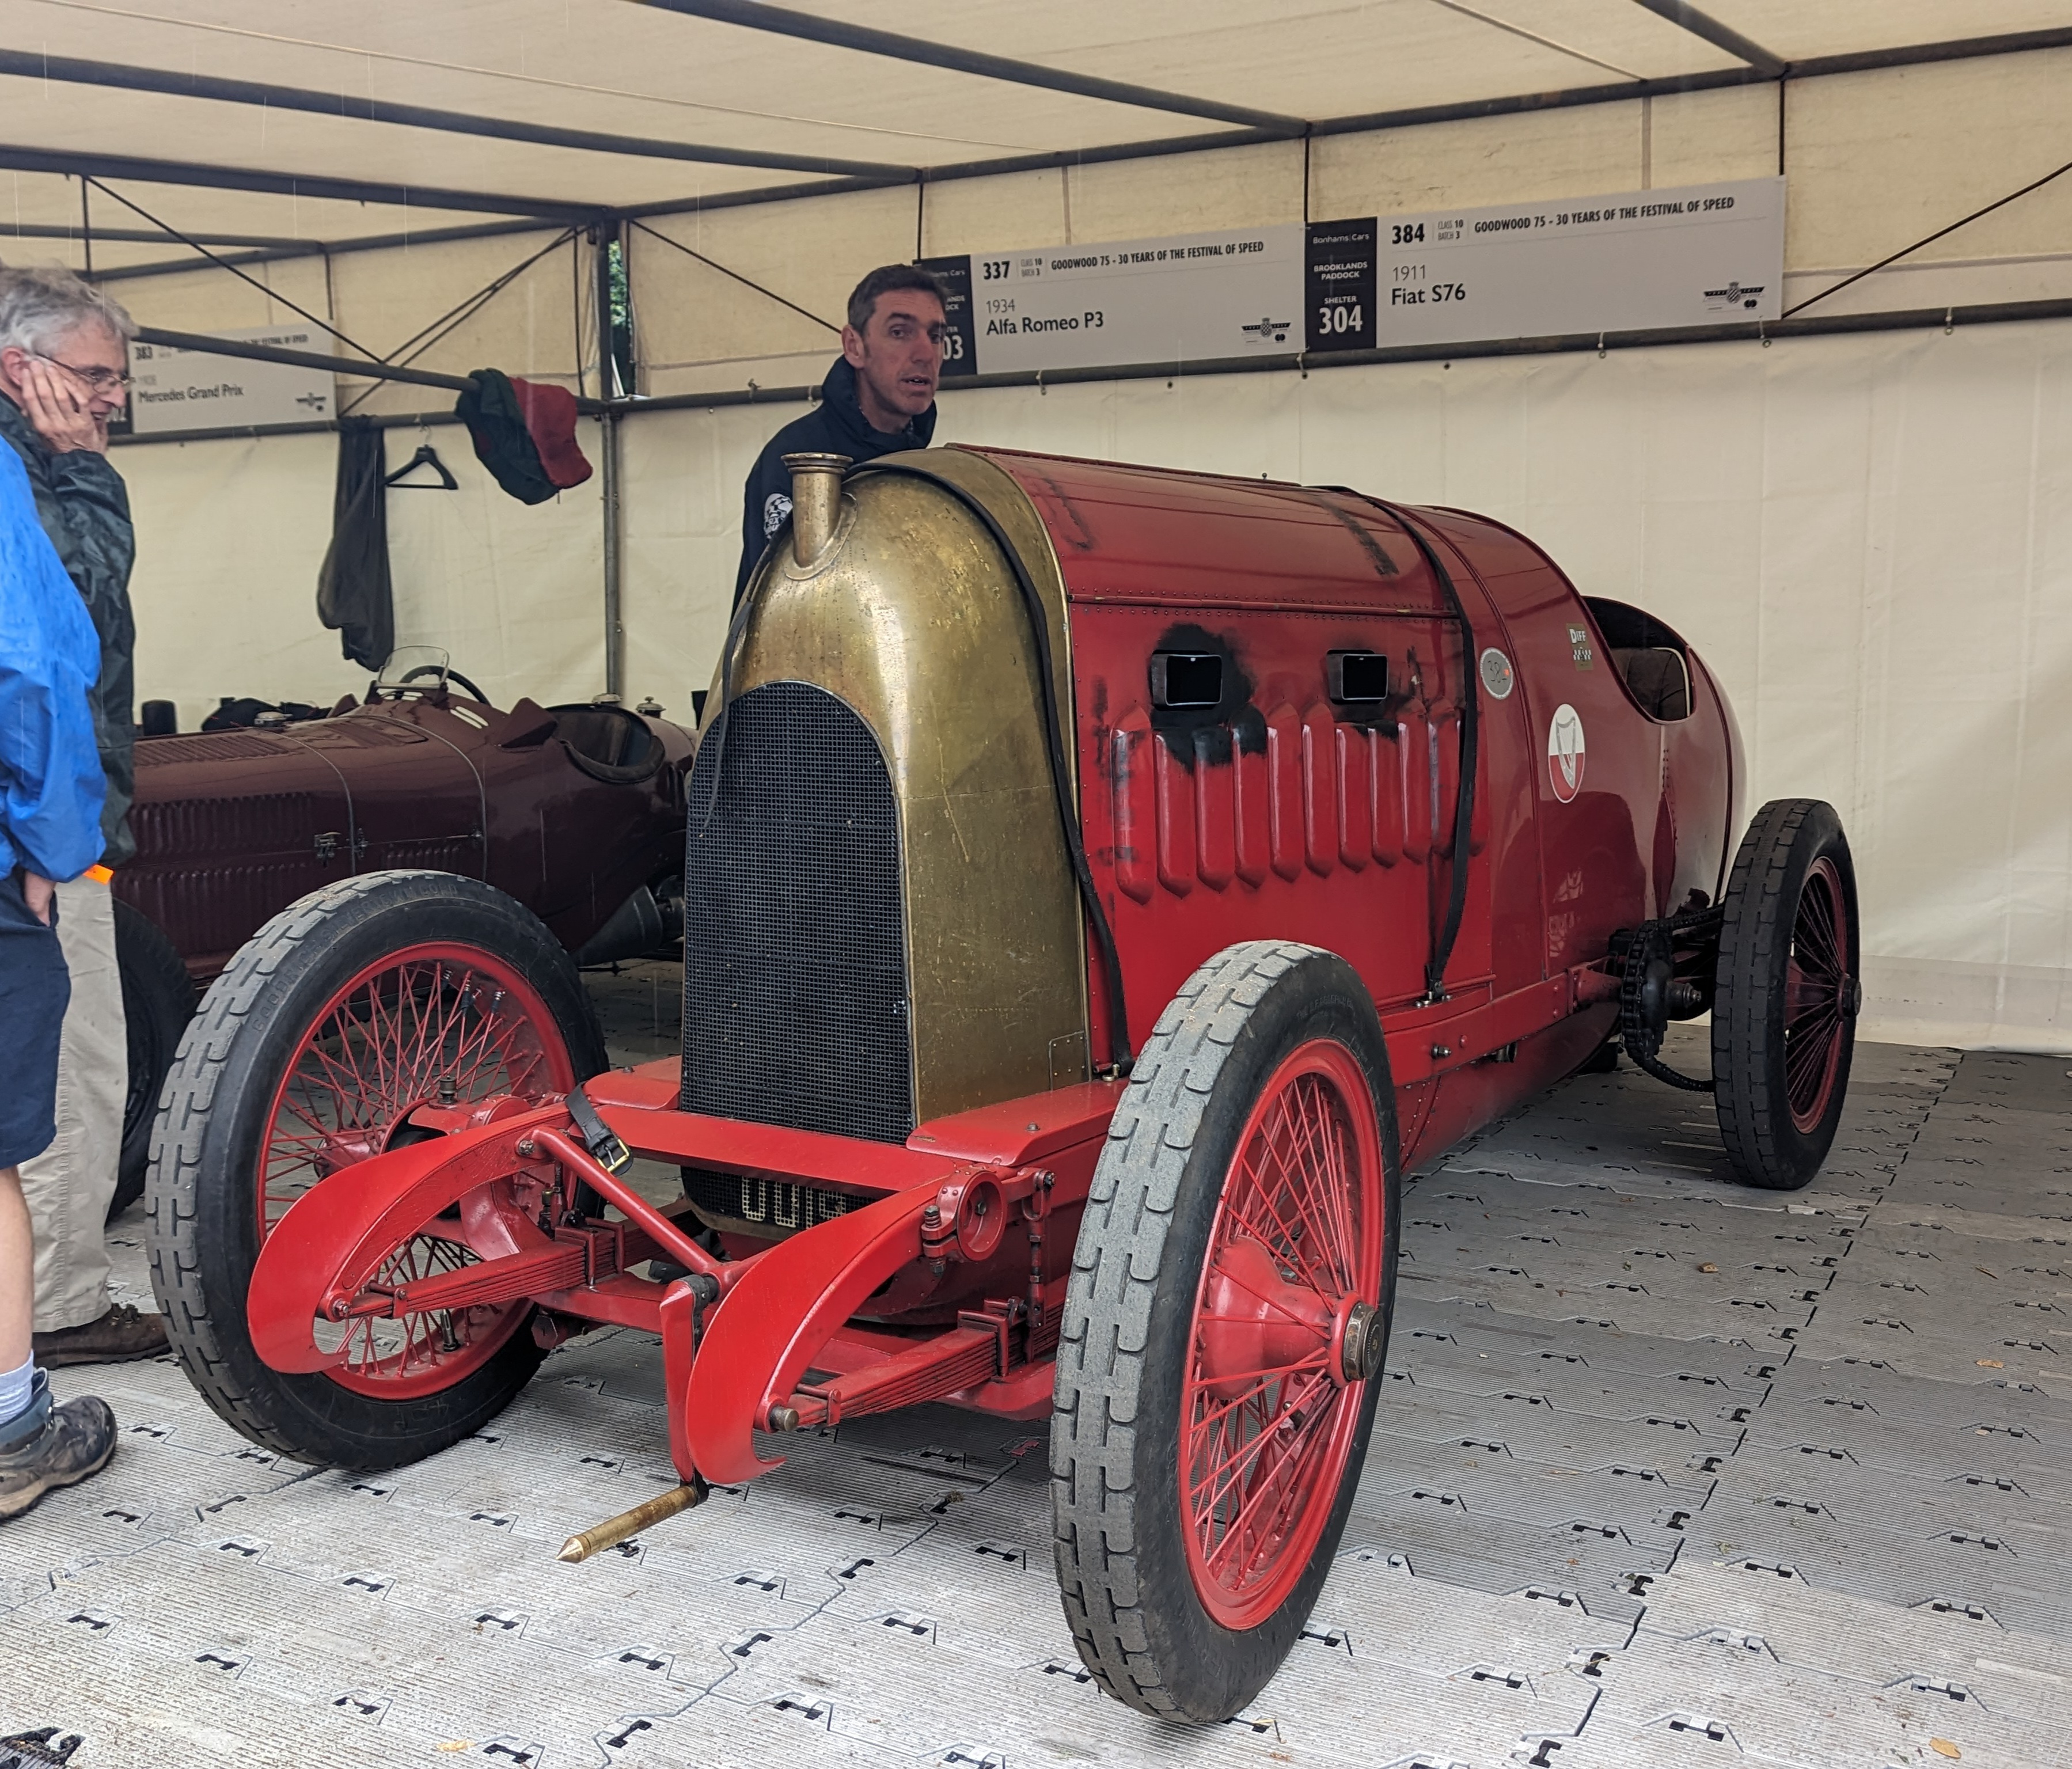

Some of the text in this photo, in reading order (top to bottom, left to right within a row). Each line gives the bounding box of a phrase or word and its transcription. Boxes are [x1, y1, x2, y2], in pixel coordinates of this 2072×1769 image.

[1455, 219, 1463, 228] 10
[1474, 217, 1531, 233] GOODWOOD
[1534, 215, 1546, 227] 75
[1556, 214, 1569, 226] 30
[1572, 210, 1600, 224] YEARS
[1603, 209, 1616, 221] OF
[1619, 206, 1638, 219] THE
[1641, 202, 1684, 217] FESTIVAL
[1687, 200, 1701, 212] OF
[1703, 196, 1735, 211] SPEED
[1392, 223, 1425, 244] 384
[1456, 231, 1460, 239] 3
[1051, 256, 1098, 271] GOODWOOD
[1100, 255, 1110, 266] 75
[1118, 254, 1129, 264] 30
[1130, 251, 1155, 263] YEARS
[1157, 250, 1167, 260] OF
[1170, 248, 1185, 259] THE
[1187, 245, 1223, 258] FESTIVAL
[1225, 244, 1236, 254] OF
[1238, 241, 1263, 253] SPEED
[983, 260, 1010, 280] 337
[1314, 261, 1368, 272] BROOKLANDS
[1321, 271, 1360, 280] PADDOCK
[1392, 264, 1425, 282] 1911
[1324, 295, 1357, 304] SHELTER
[1392, 283, 1466, 305] Fiat S76
[986, 299, 1016, 314] 1934
[986, 311, 1103, 336] Alfa Romeo P3
[1319, 305, 1363, 334] 304
[943, 335, 964, 360] 03
[138, 383, 244, 403] Mercedes Grand Prix
